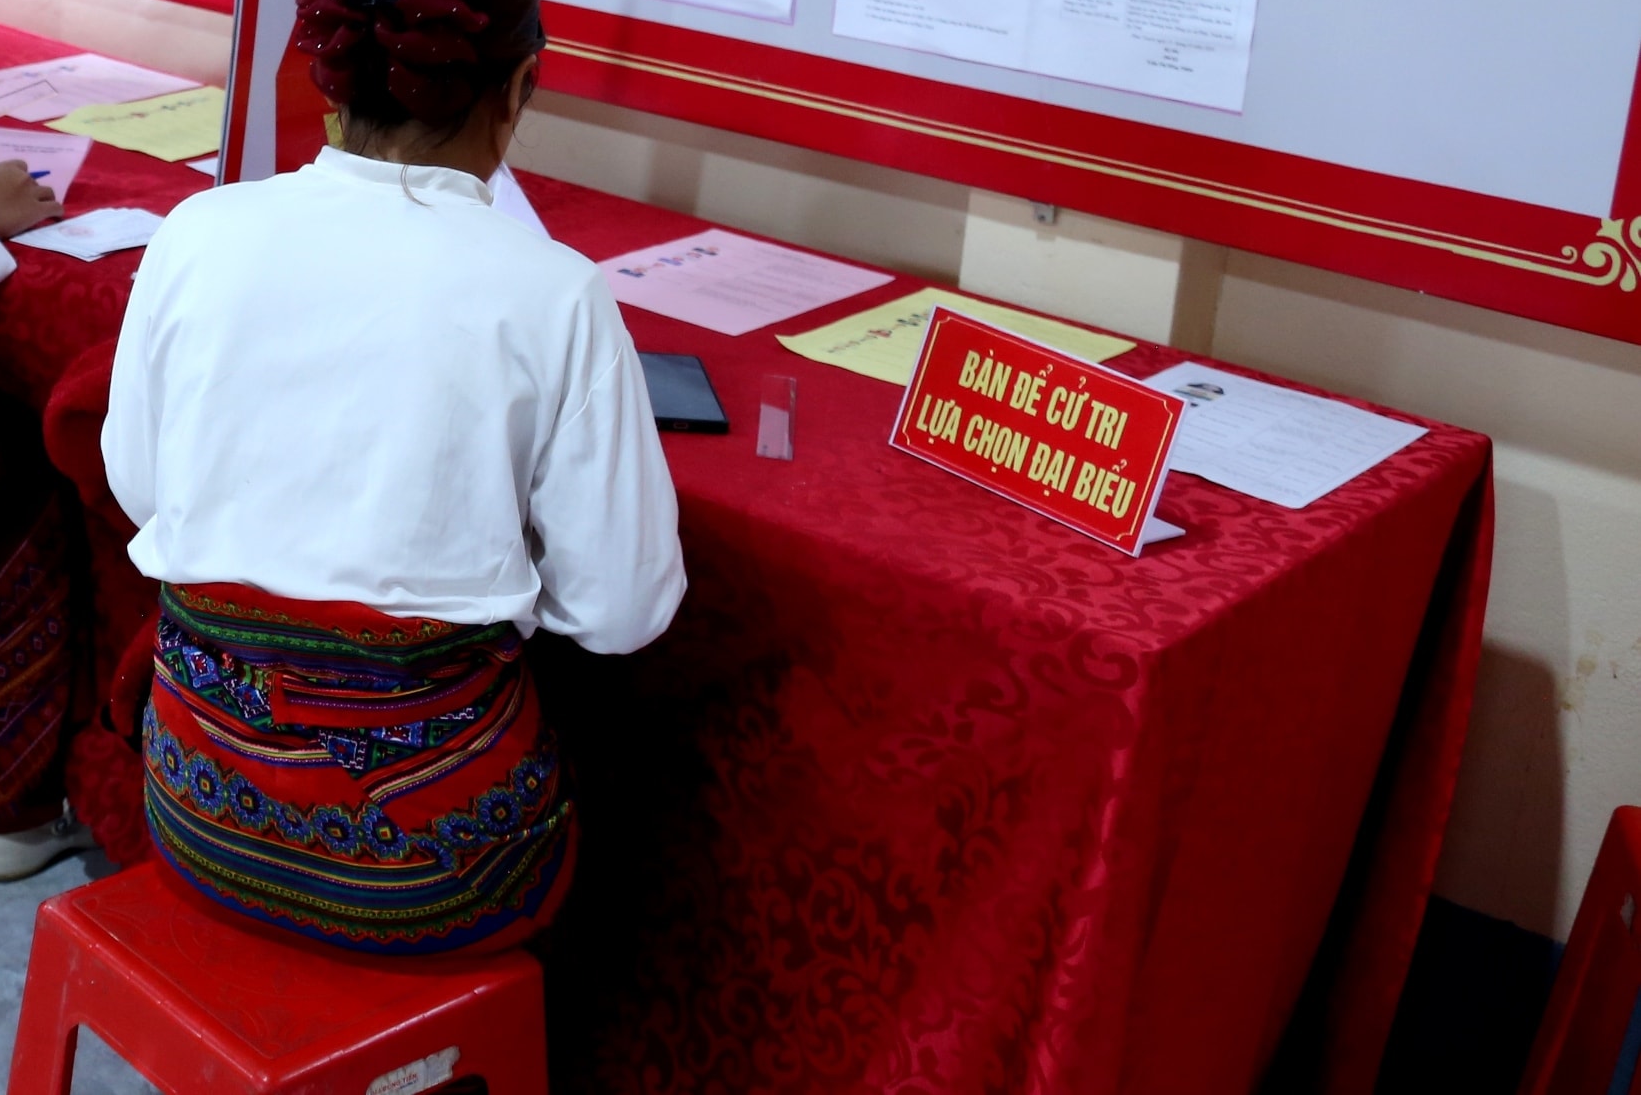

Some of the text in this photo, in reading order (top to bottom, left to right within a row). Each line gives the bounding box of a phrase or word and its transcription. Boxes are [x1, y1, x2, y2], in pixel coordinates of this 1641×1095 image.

[959, 349, 1012, 401] BÀN
[1010, 364, 1053, 416] ĐỂ
[1046, 376, 1089, 430] CỬ
[1085, 400, 1128, 450] TRI
[916, 394, 1136, 519] LỰA CHỌN ĐẠI BIỂU
